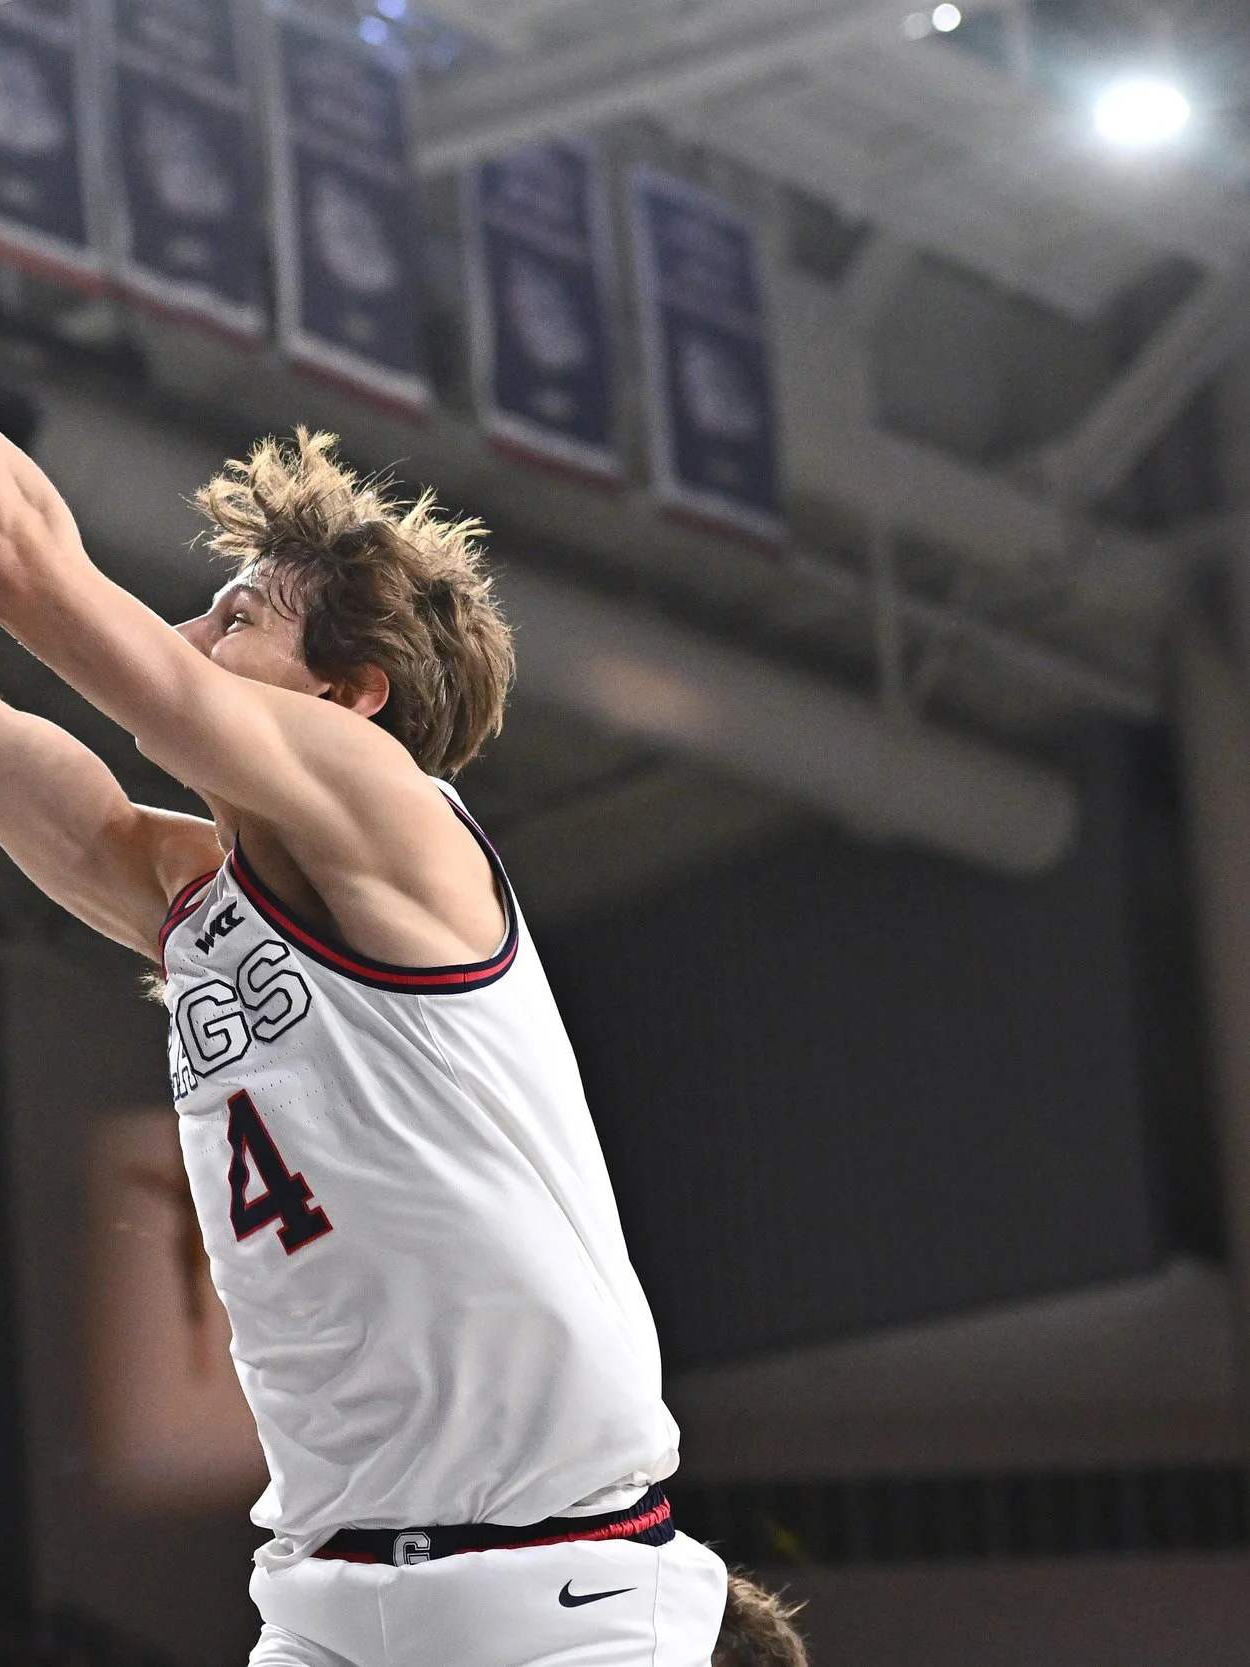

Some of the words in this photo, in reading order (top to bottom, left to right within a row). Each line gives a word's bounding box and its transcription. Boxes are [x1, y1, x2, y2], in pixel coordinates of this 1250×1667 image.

[194, 900, 246, 955] WCC
[168, 938, 313, 1102] AGS
[227, 1088, 334, 1256] 4
[392, 1531, 432, 1567] G
